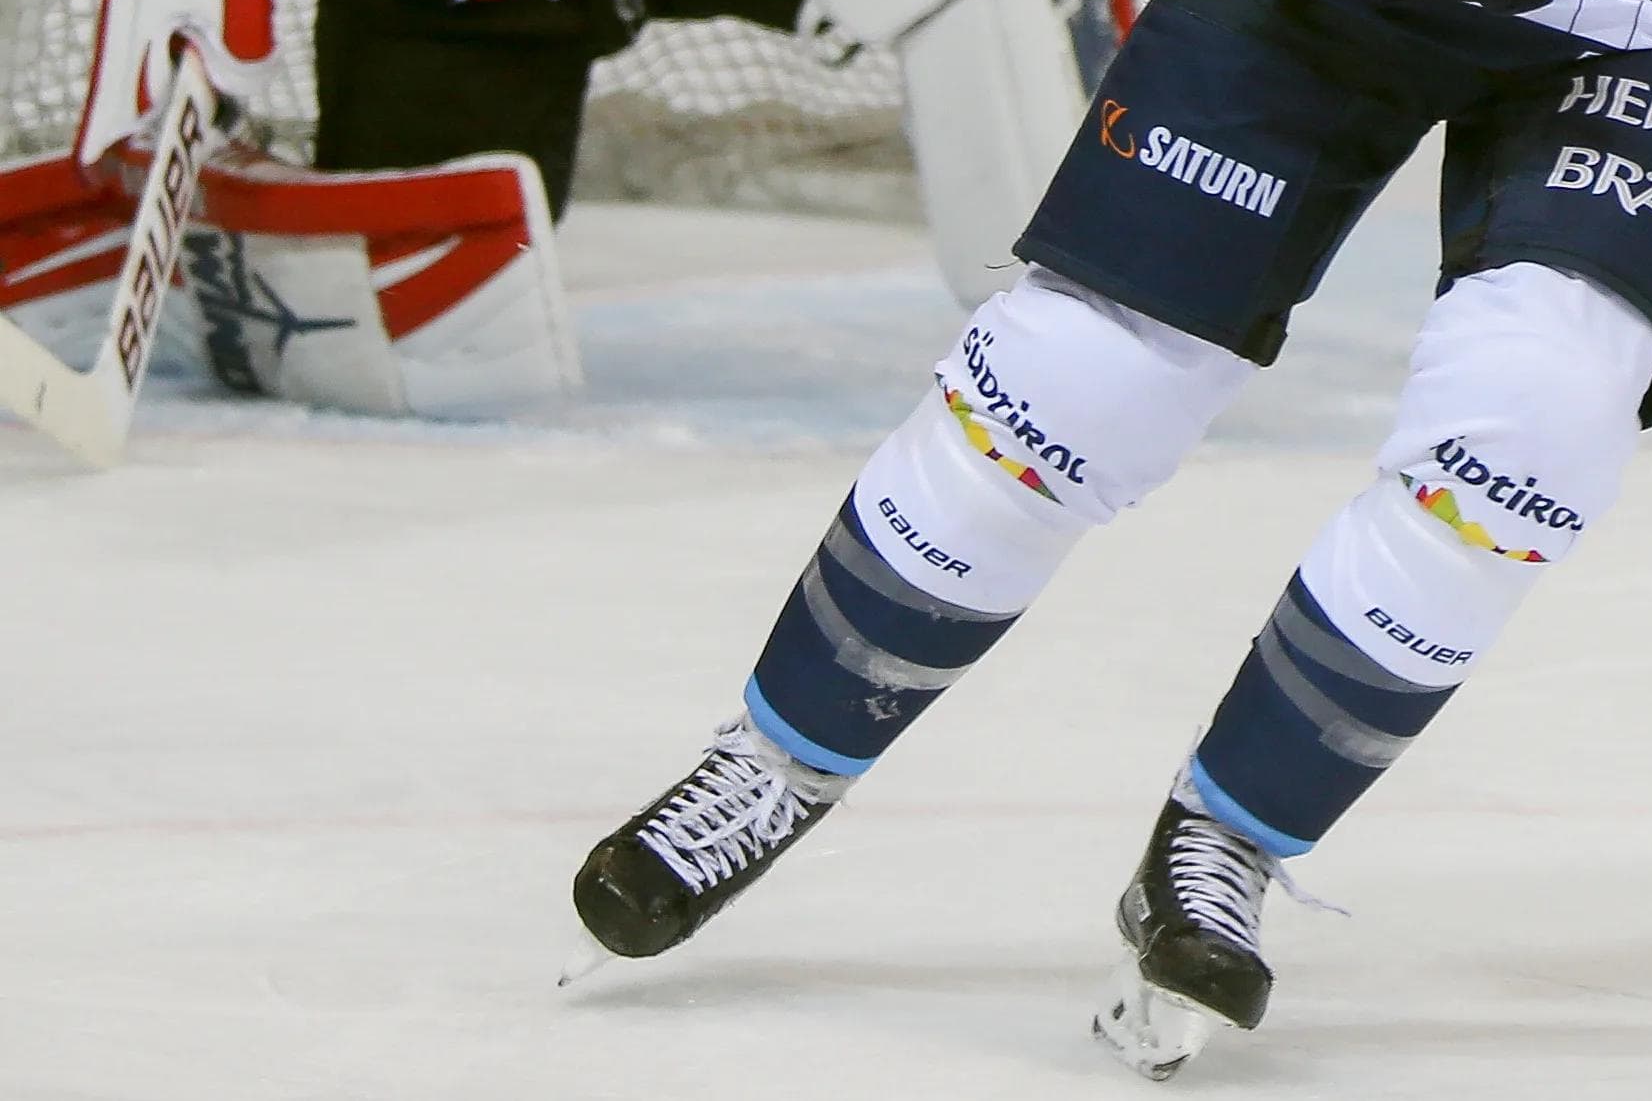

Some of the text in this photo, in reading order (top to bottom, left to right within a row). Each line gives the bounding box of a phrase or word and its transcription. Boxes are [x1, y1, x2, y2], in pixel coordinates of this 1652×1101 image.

[1139, 125, 1287, 218] SATURN
[877, 496, 972, 580] BAUER
[1364, 606, 1474, 666] BAUER
